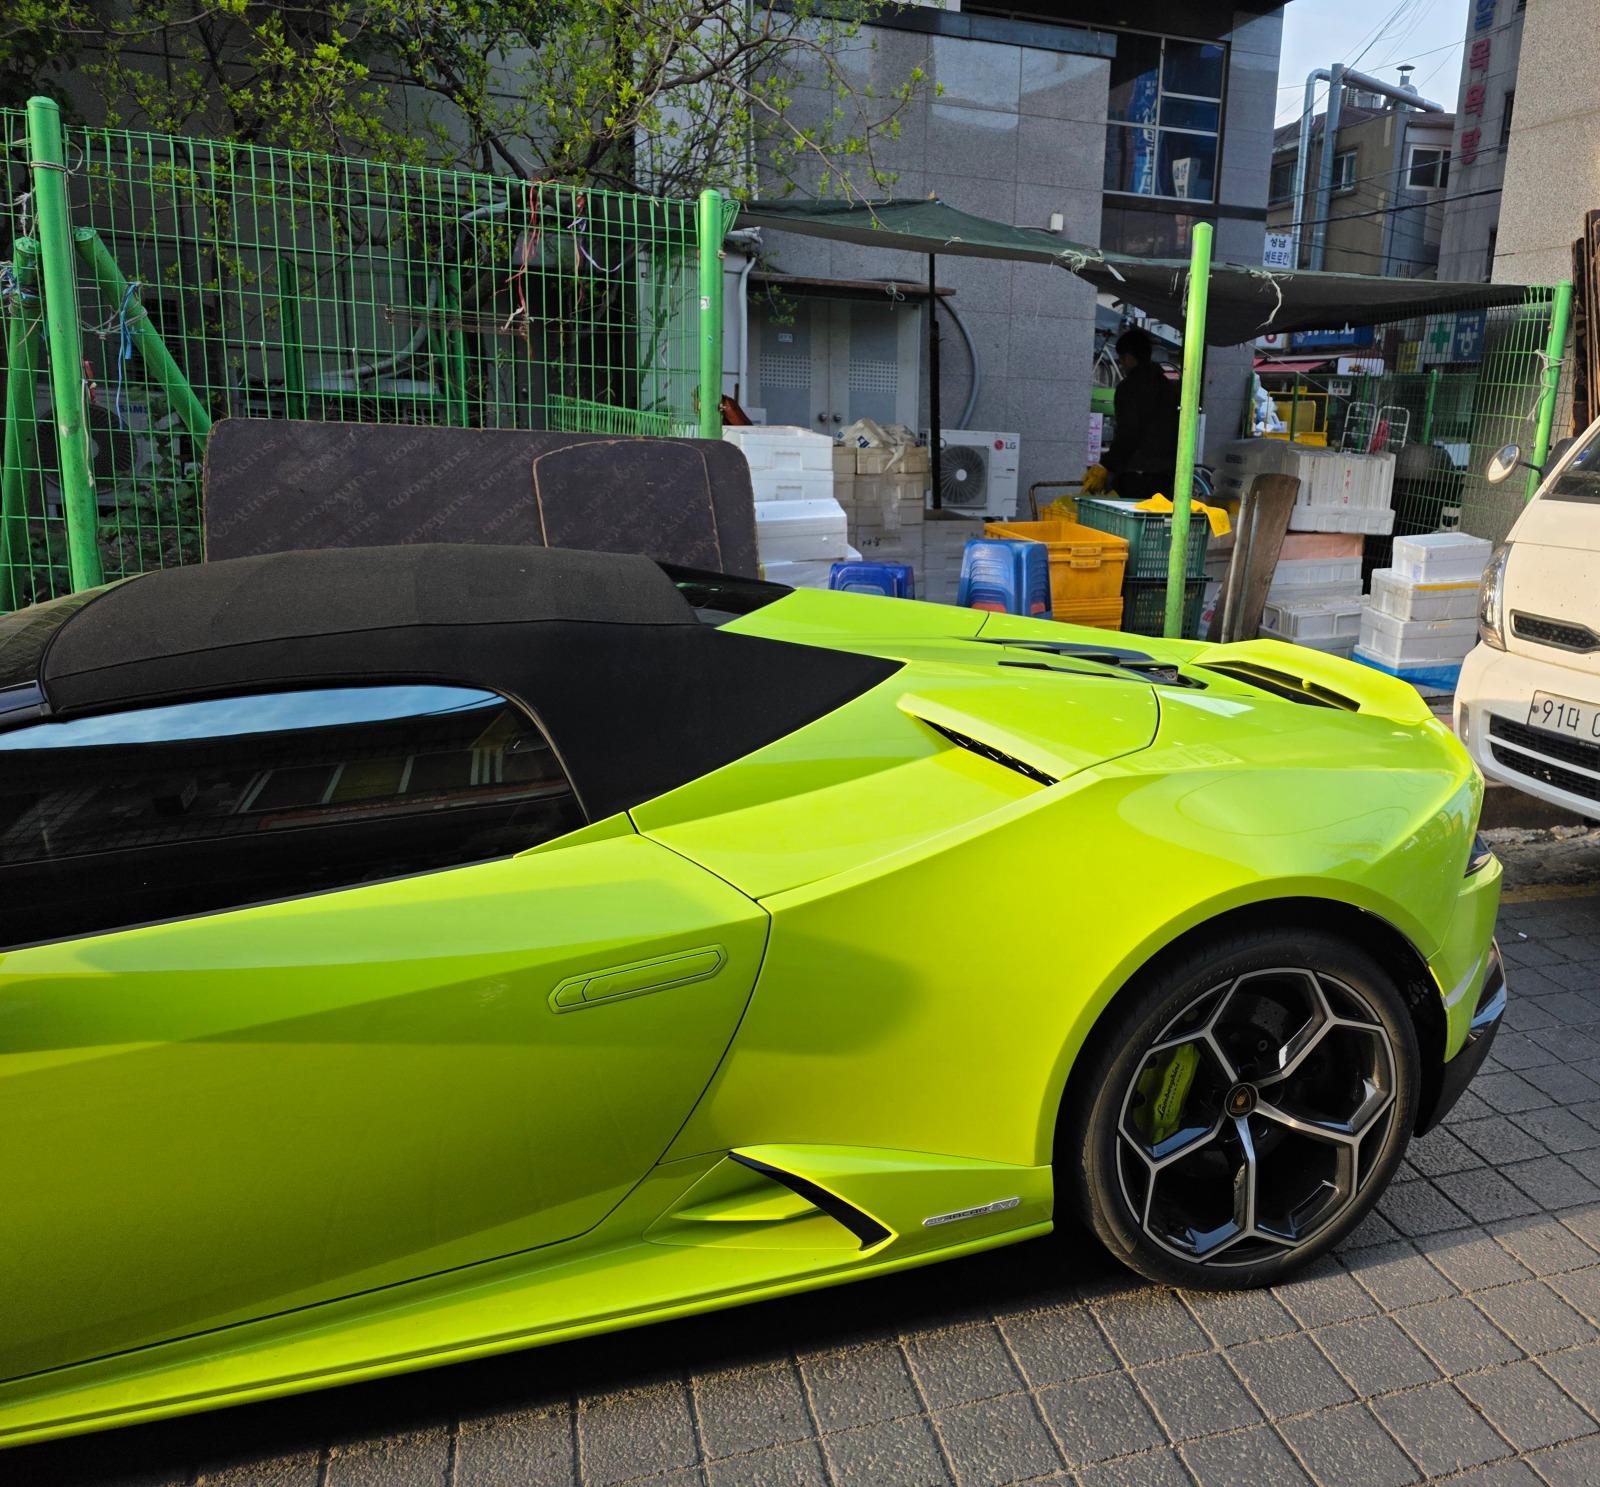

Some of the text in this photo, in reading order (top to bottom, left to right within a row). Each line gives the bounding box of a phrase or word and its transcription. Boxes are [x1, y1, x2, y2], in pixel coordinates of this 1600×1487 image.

[1270, 238, 1287, 248] 성남
[1005, 441, 1017, 449] LG
[1158, 1062, 1180, 1120] Lamborghini
